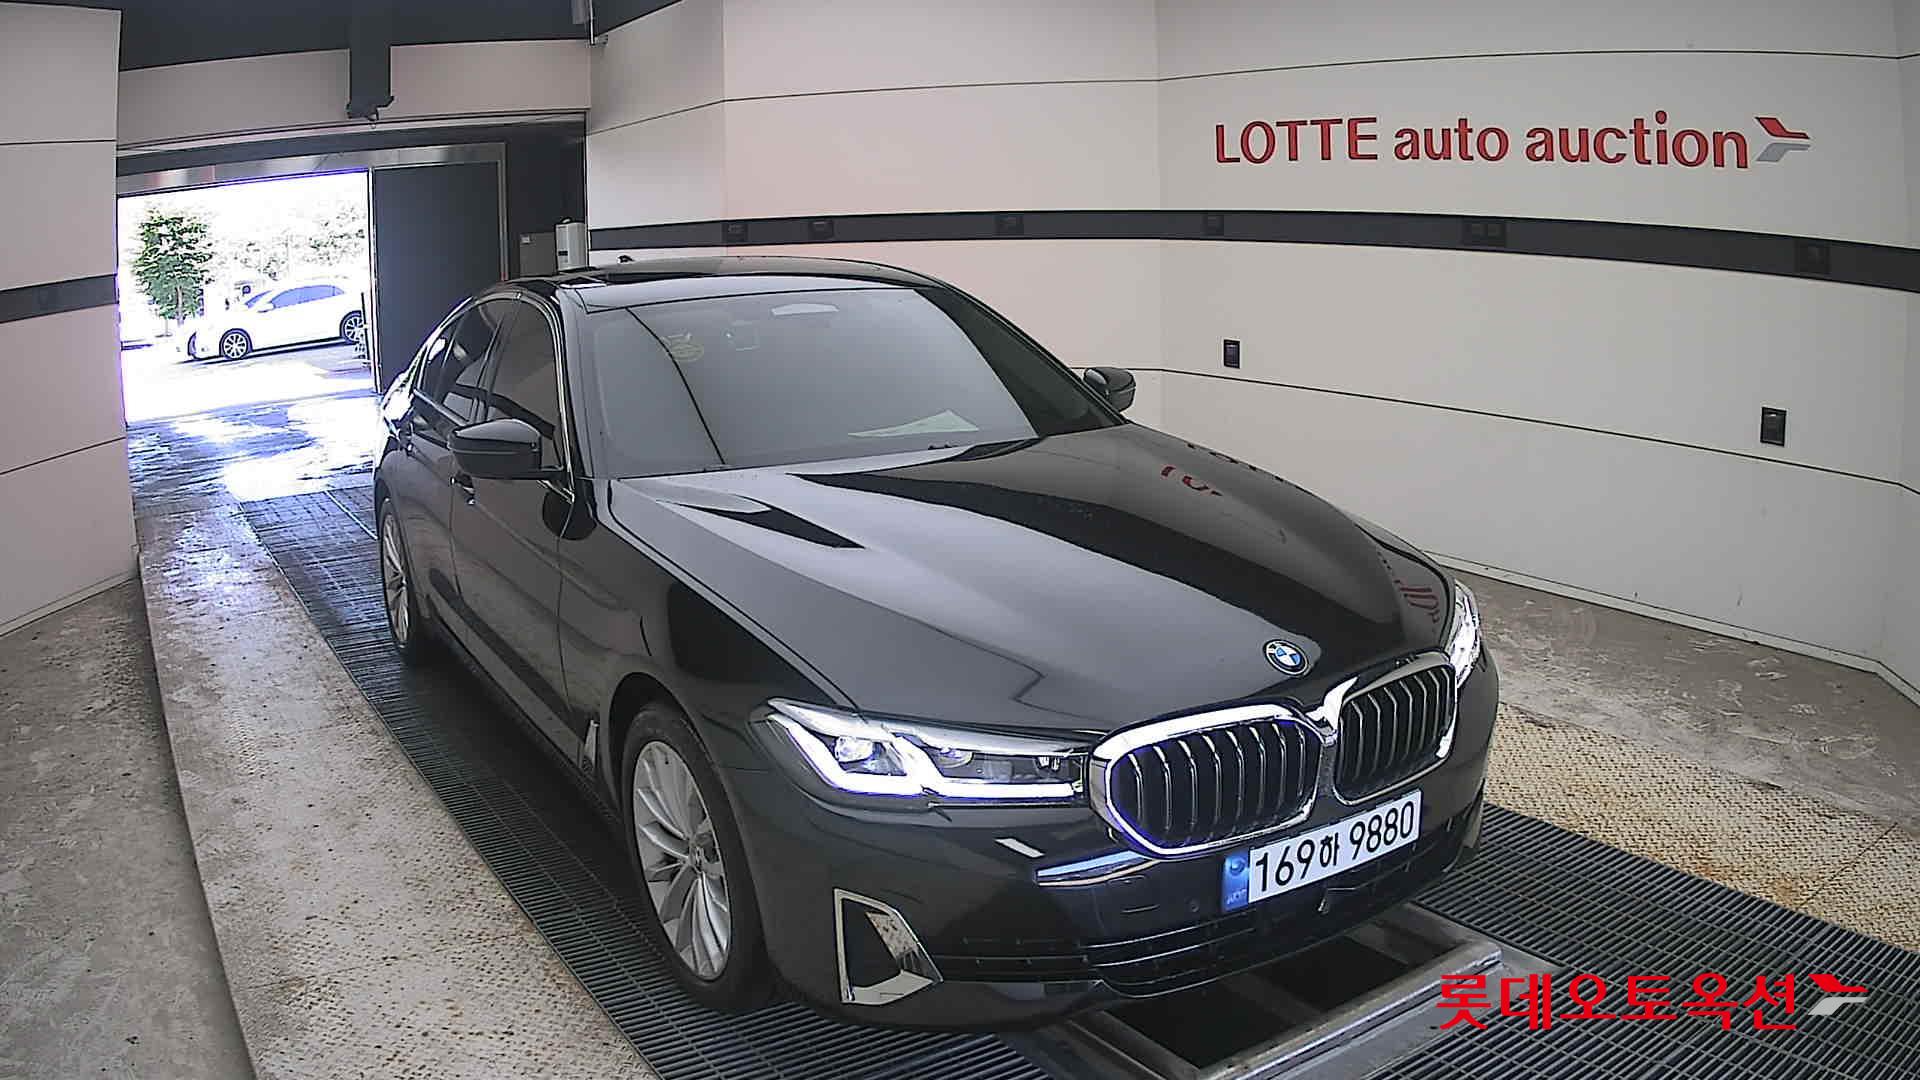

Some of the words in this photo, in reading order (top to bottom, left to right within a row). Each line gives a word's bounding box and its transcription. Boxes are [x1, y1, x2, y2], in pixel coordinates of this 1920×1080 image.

[1215, 116, 1378, 164] LOTTE
[1394, 118, 1510, 162] auto
[1525, 110, 1749, 169] auction
[1255, 832, 1340, 892] 169하
[1350, 801, 1415, 860] 9880
